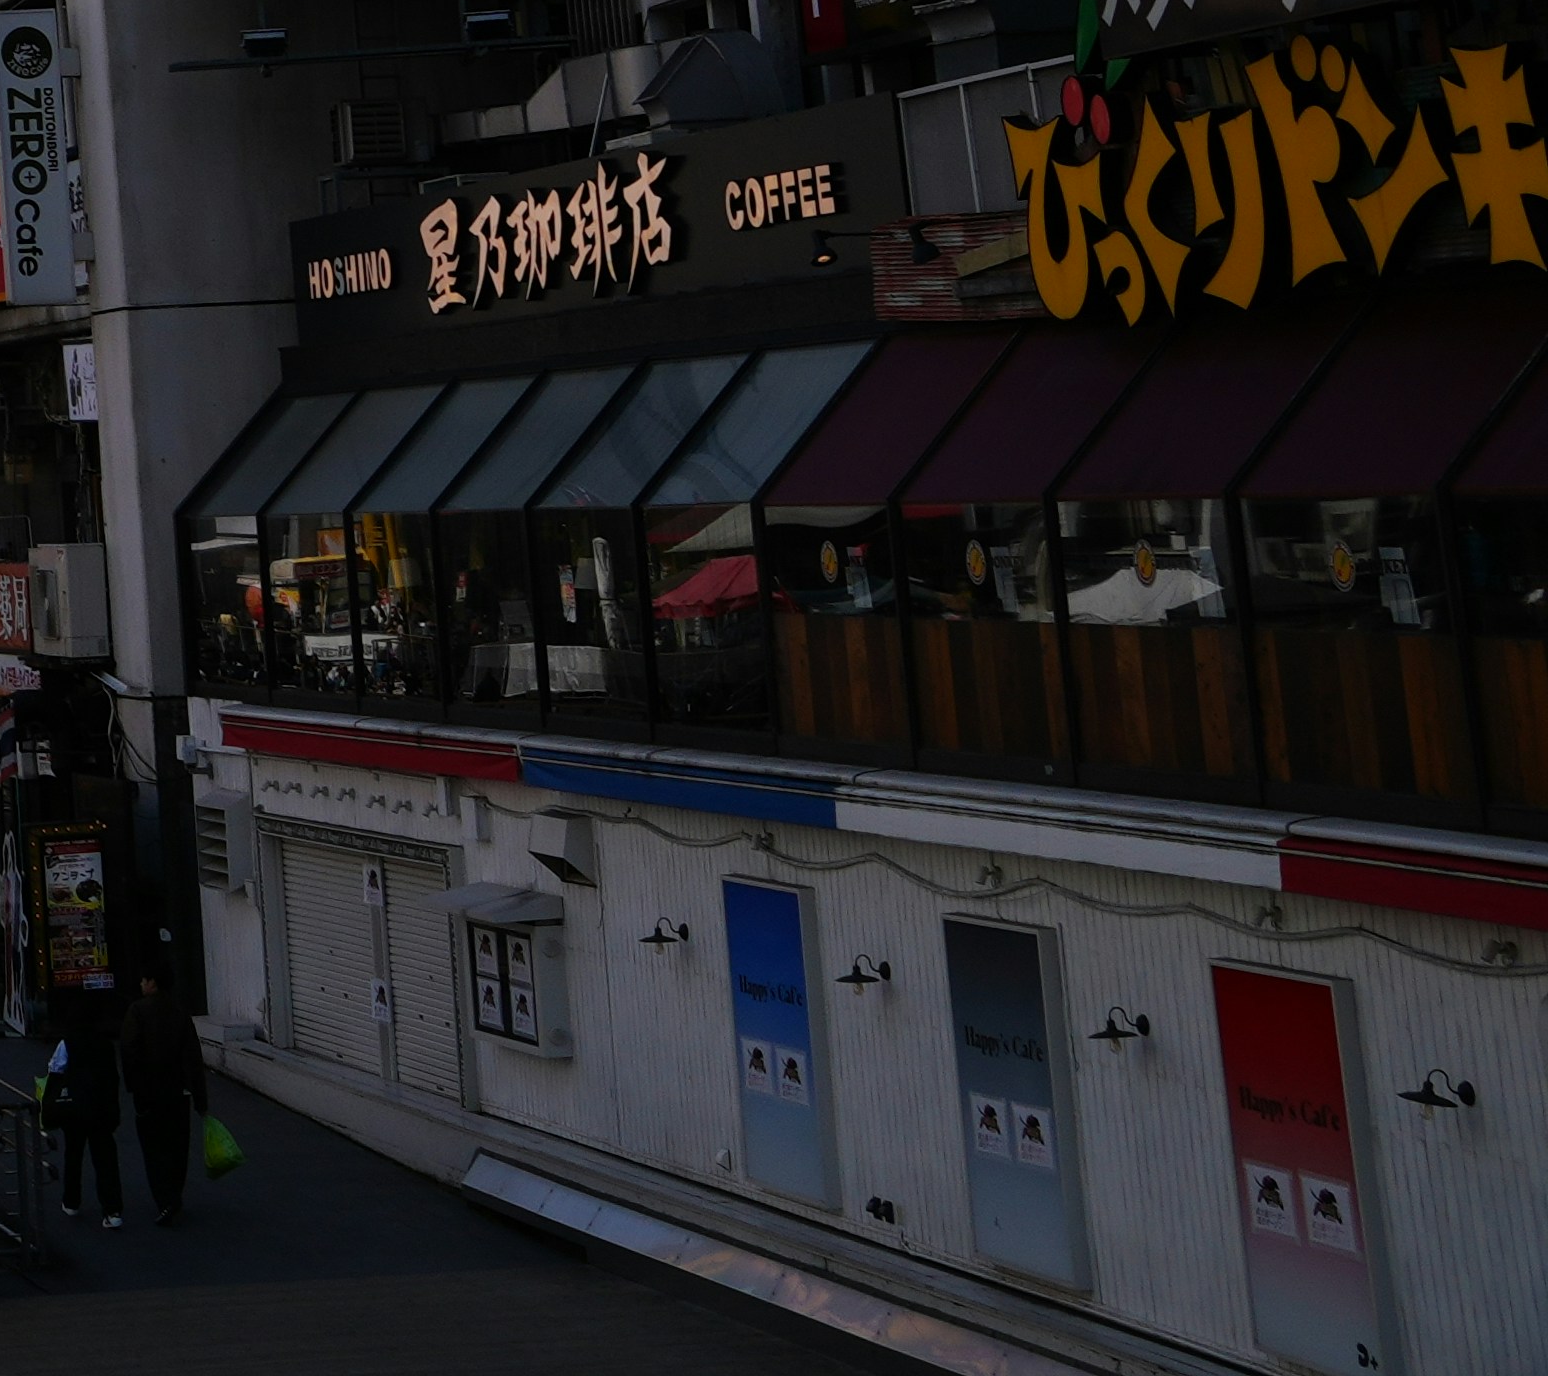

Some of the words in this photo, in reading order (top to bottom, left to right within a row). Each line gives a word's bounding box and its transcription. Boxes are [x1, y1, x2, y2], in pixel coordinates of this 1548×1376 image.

[6, 87, 48, 196] ZERO
[43, 87, 59, 172] DOUTONBORI
[725, 163, 836, 232] COFFEE
[419, 151, 673, 316] 星乃珈琲店
[307, 248, 393, 300] HOSHINO
[738, 973, 776, 1004] Happy's
[776, 981, 804, 1008] Cafe
[964, 1024, 1012, 1056] Happy's
[1012, 1034, 1044, 1064] Cafe
[1238, 1084, 1299, 1124] Happy's
[1300, 1099, 1342, 1133] Cafe
